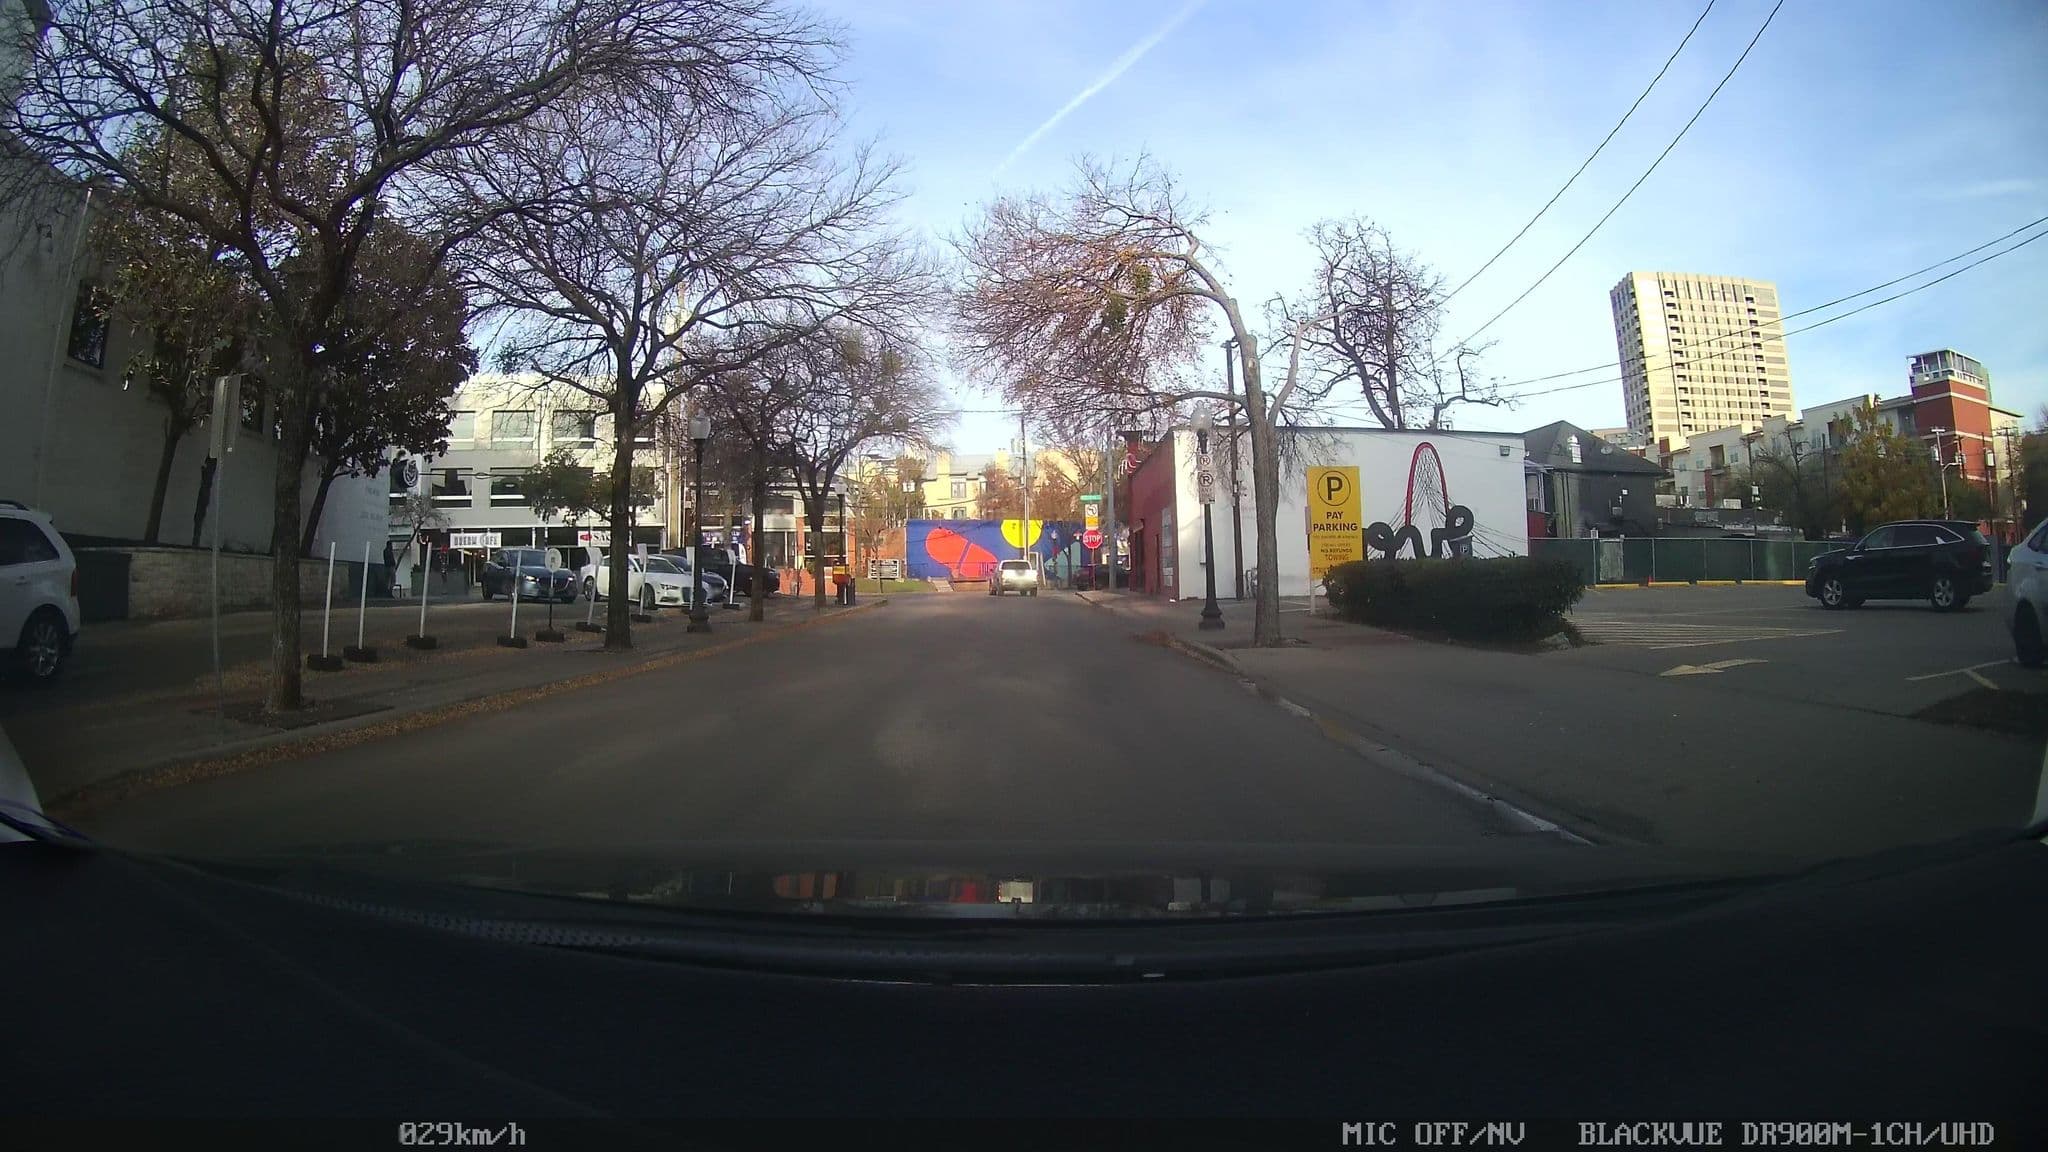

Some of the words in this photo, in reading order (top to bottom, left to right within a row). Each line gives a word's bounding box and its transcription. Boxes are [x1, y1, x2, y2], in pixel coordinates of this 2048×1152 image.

[1327, 476, 1343, 501] P
[1326, 511, 1343, 520] PAY
[1313, 522, 1358, 532] PARKING
[1083, 533, 1102, 543] STOP
